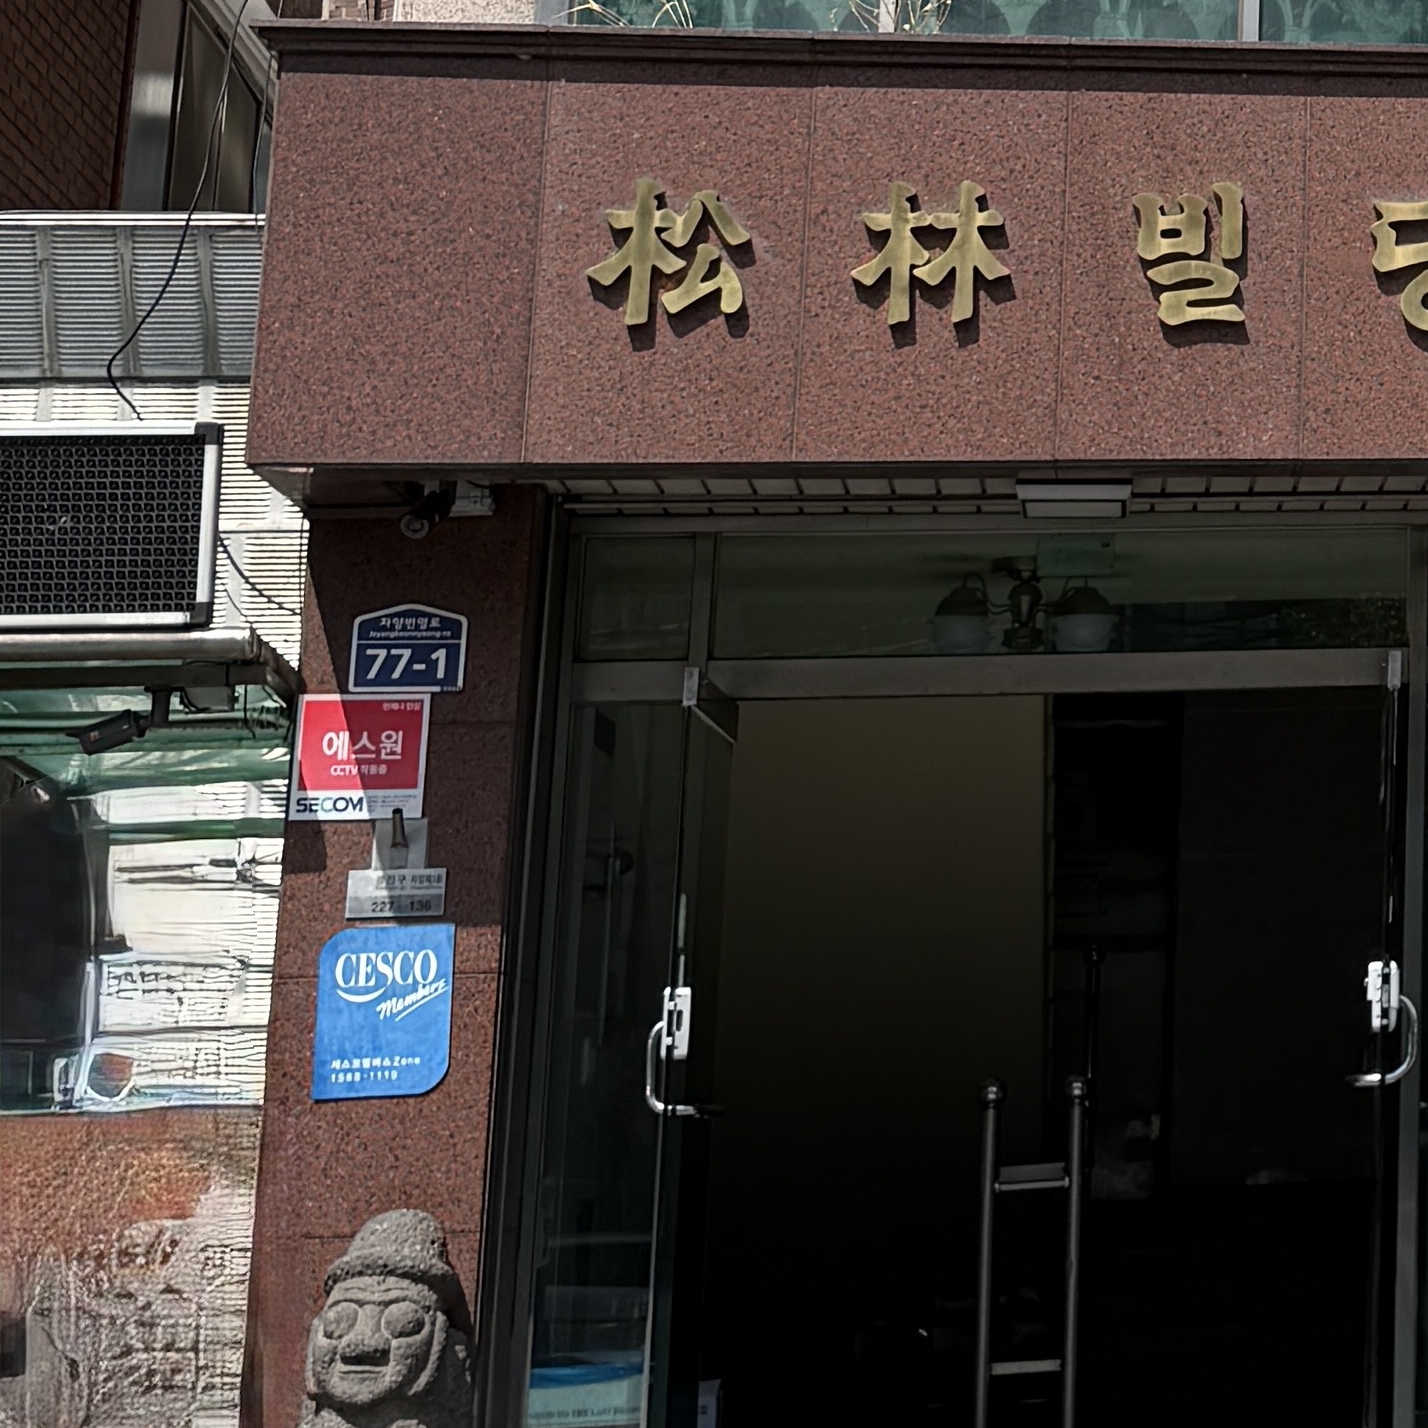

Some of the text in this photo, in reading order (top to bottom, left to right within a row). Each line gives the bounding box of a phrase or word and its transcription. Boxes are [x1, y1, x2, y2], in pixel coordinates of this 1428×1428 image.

[365, 648, 447, 680] 77-1
[322, 730, 404, 761] 에스원
[330, 764, 358, 776] CCTV
[296, 796, 364, 813] SECOM
[371, 900, 395, 913] 227
[335, 949, 438, 989] CESCO
[376, 978, 448, 1021] Members
